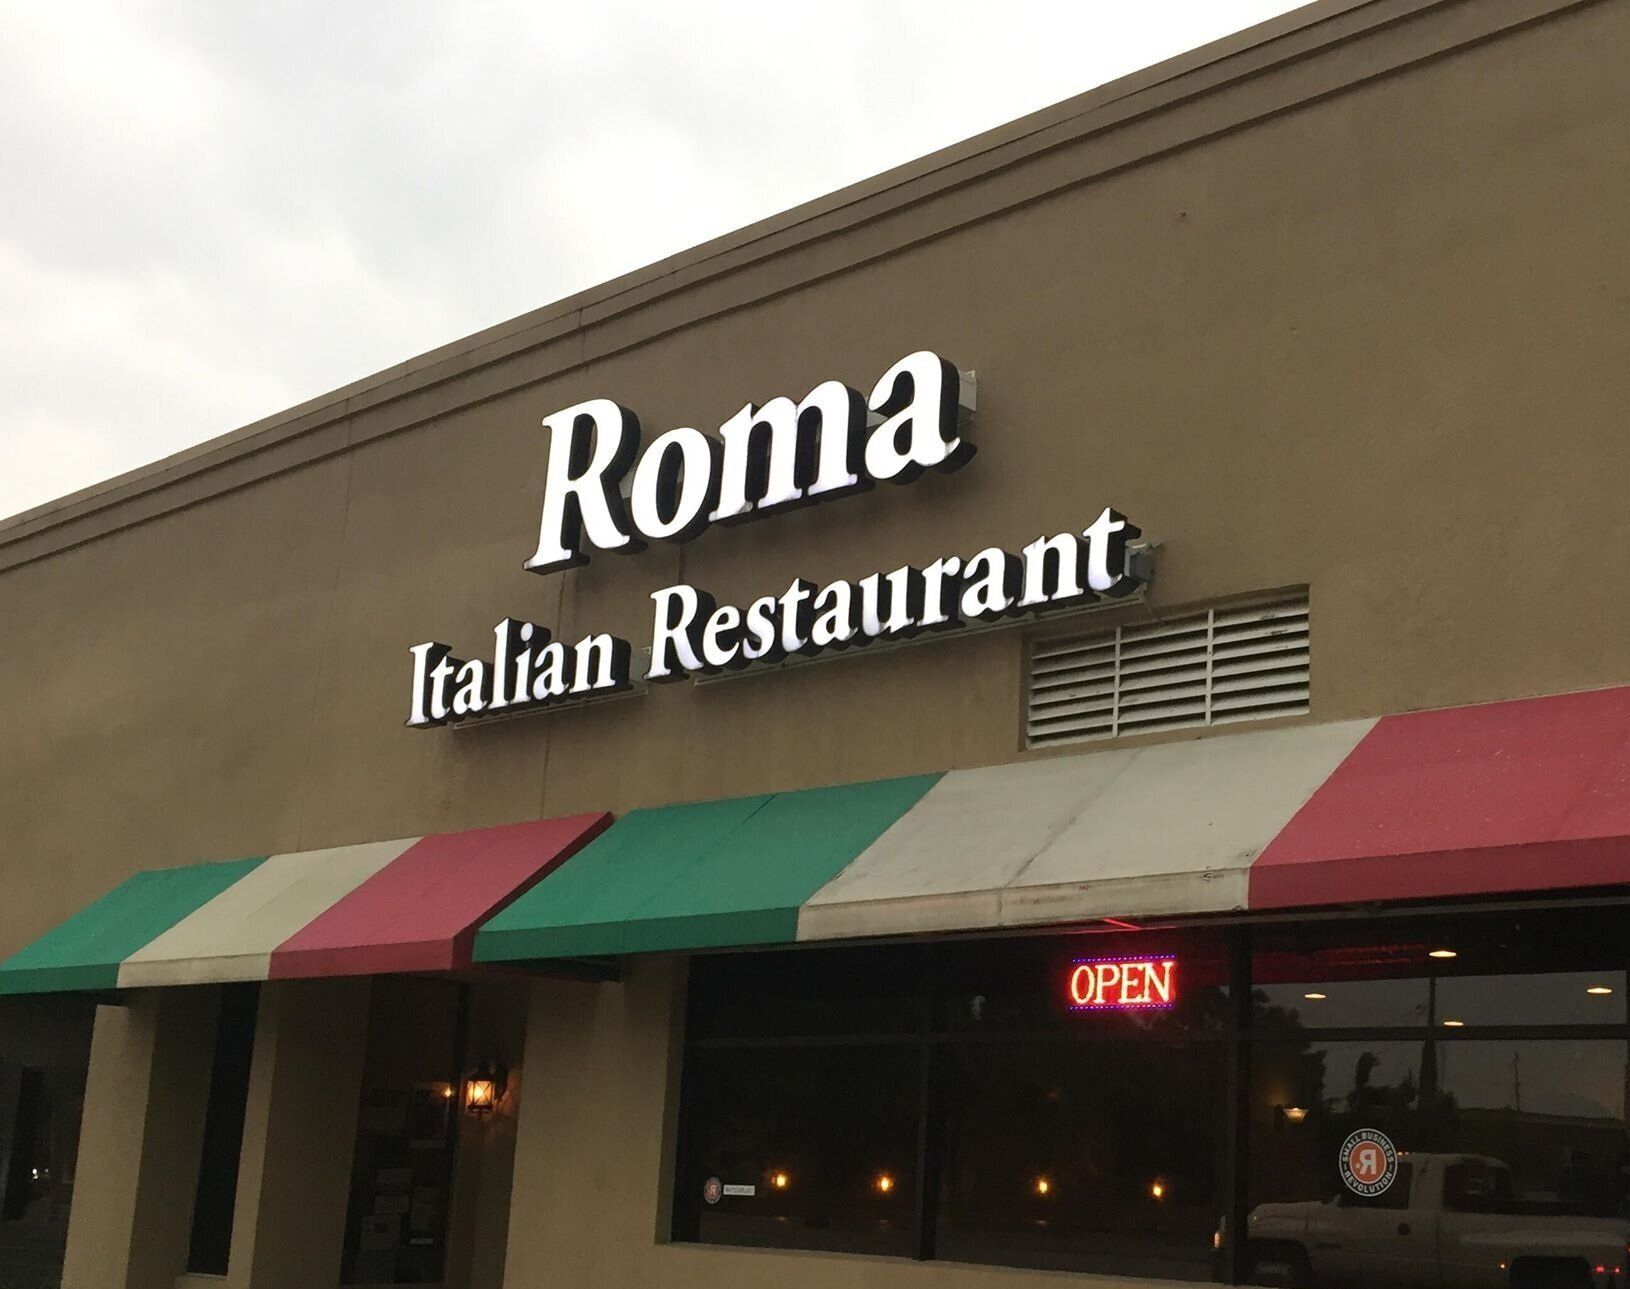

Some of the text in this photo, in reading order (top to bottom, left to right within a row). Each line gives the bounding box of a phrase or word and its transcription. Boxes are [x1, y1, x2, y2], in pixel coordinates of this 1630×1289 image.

[523, 349, 961, 571] Roma
[405, 506, 1128, 727] Italian Restaurant
[1071, 961, 1175, 1004] OPEN
[1342, 1131, 1394, 1163] SMALL BUSINESS
[1344, 1170, 1393, 1193] REVOLUTION
